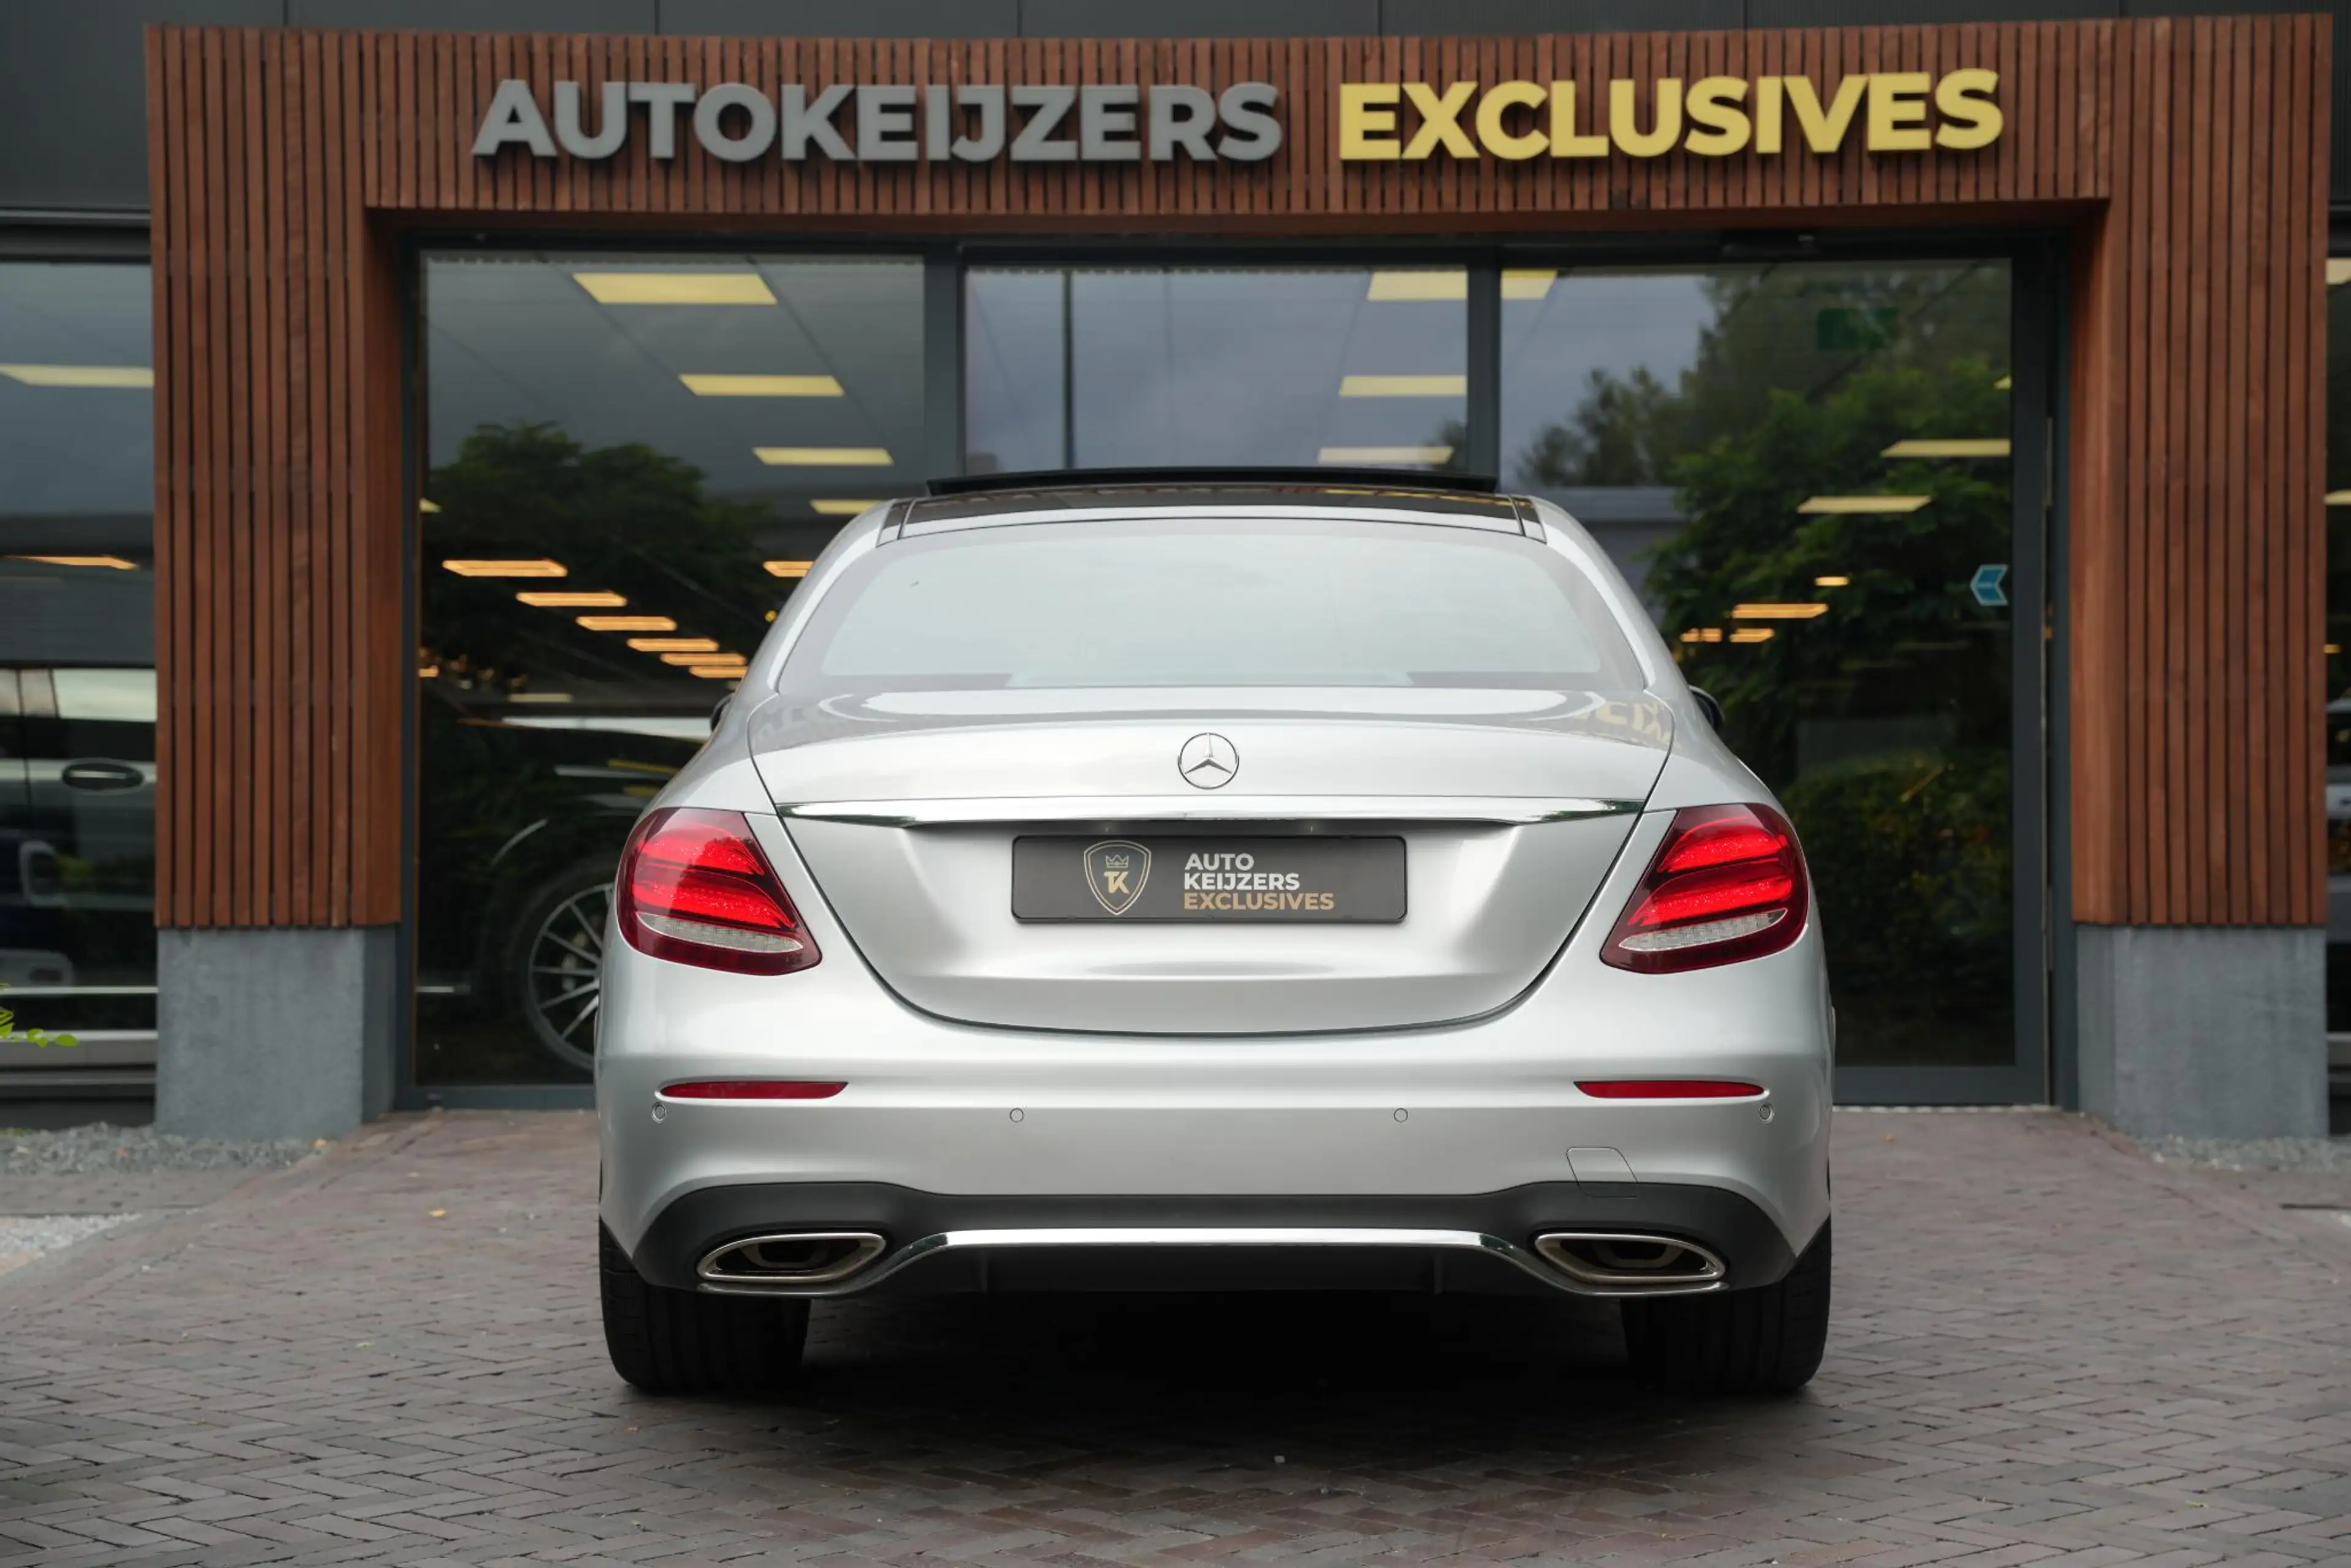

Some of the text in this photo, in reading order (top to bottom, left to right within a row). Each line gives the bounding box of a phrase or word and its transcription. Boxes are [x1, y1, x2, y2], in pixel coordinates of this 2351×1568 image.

[471, 70, 2003, 161] AUTOKEIJZERS EXCLUSIVES
[1184, 853, 1254, 871] AUTO
[1184, 872, 1300, 890] KEIJZERS
[1184, 893, 1335, 910] EXCLUSIVES
